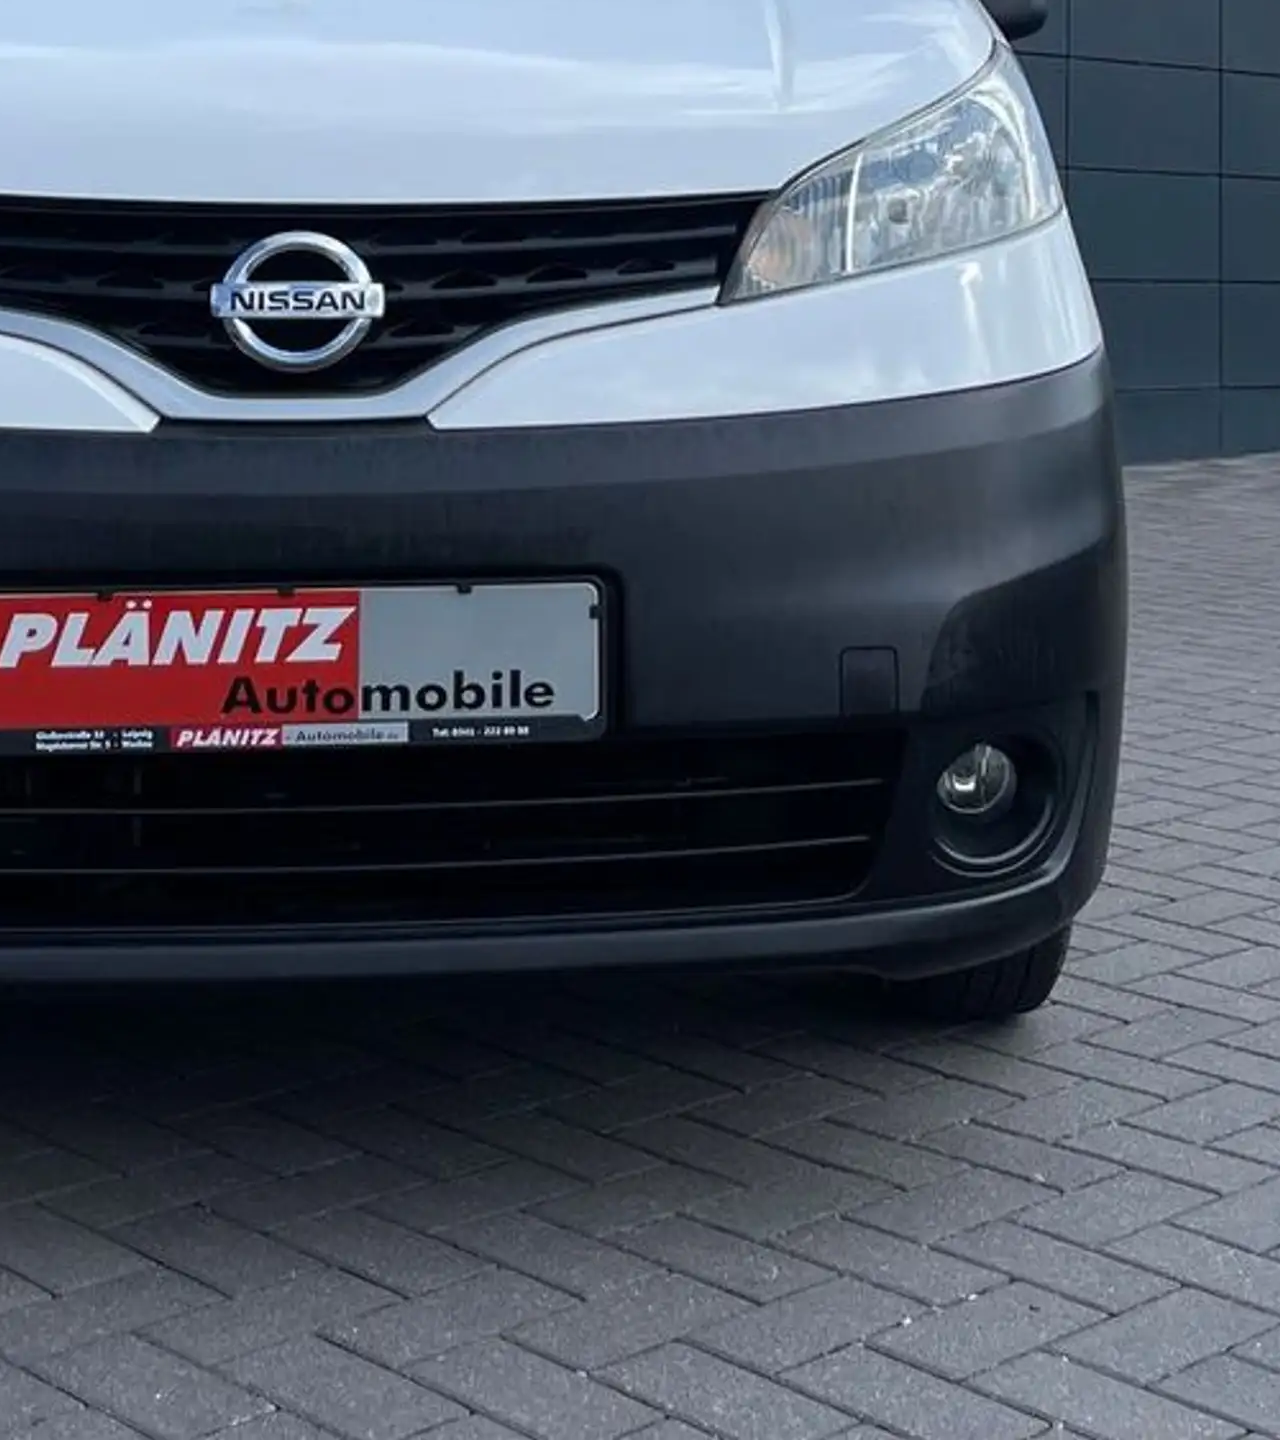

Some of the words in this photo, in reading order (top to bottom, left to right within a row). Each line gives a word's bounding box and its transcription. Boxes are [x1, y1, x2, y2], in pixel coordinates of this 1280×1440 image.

[230, 290, 365, 311] NISSAN
[220, 669, 556, 716] Automobile
[295, 727, 385, 742] Automobile
